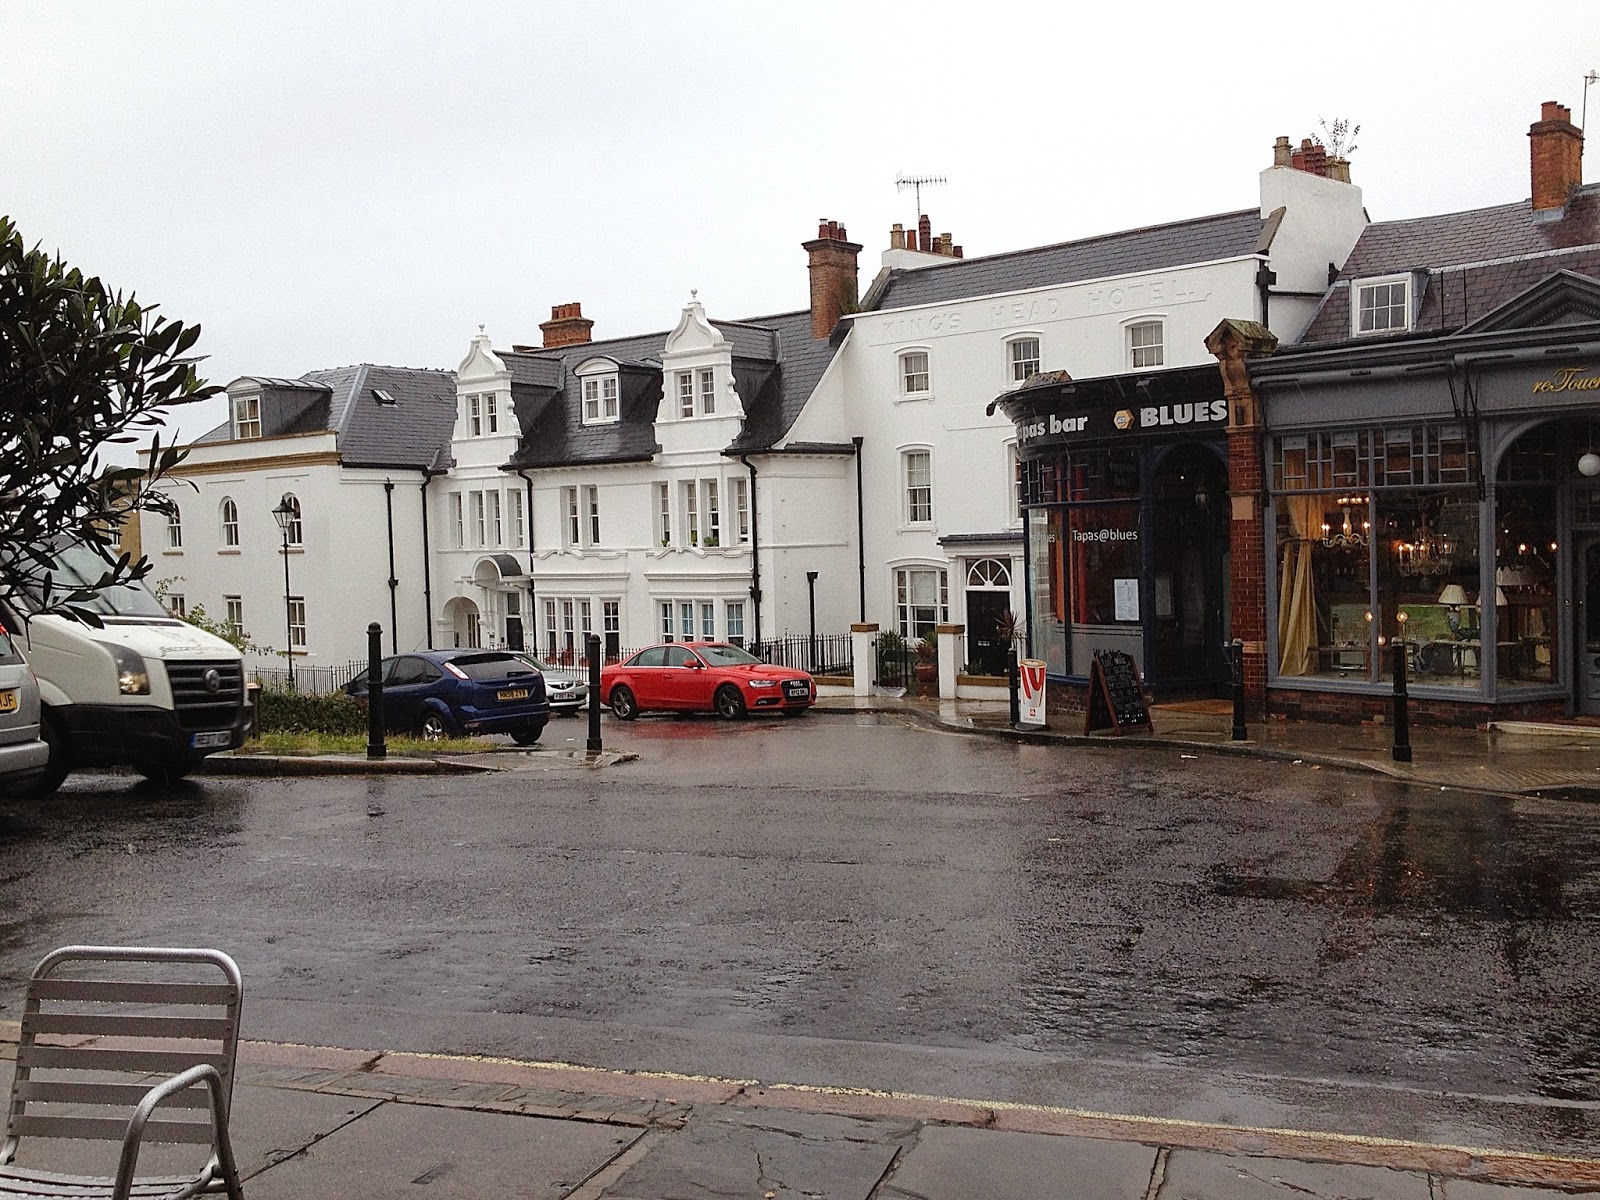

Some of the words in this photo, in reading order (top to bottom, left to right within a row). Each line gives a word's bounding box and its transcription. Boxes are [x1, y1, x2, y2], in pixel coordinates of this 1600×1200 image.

[990, 298, 1060, 327] HEAD
[1088, 280, 1194, 310] HOTEL
[1140, 399, 1227, 427] BLUES
[1049, 414, 1088, 434] bar
[1072, 528, 1138, 544] Tapas@blues
[0, 693, 13, 707] JF
